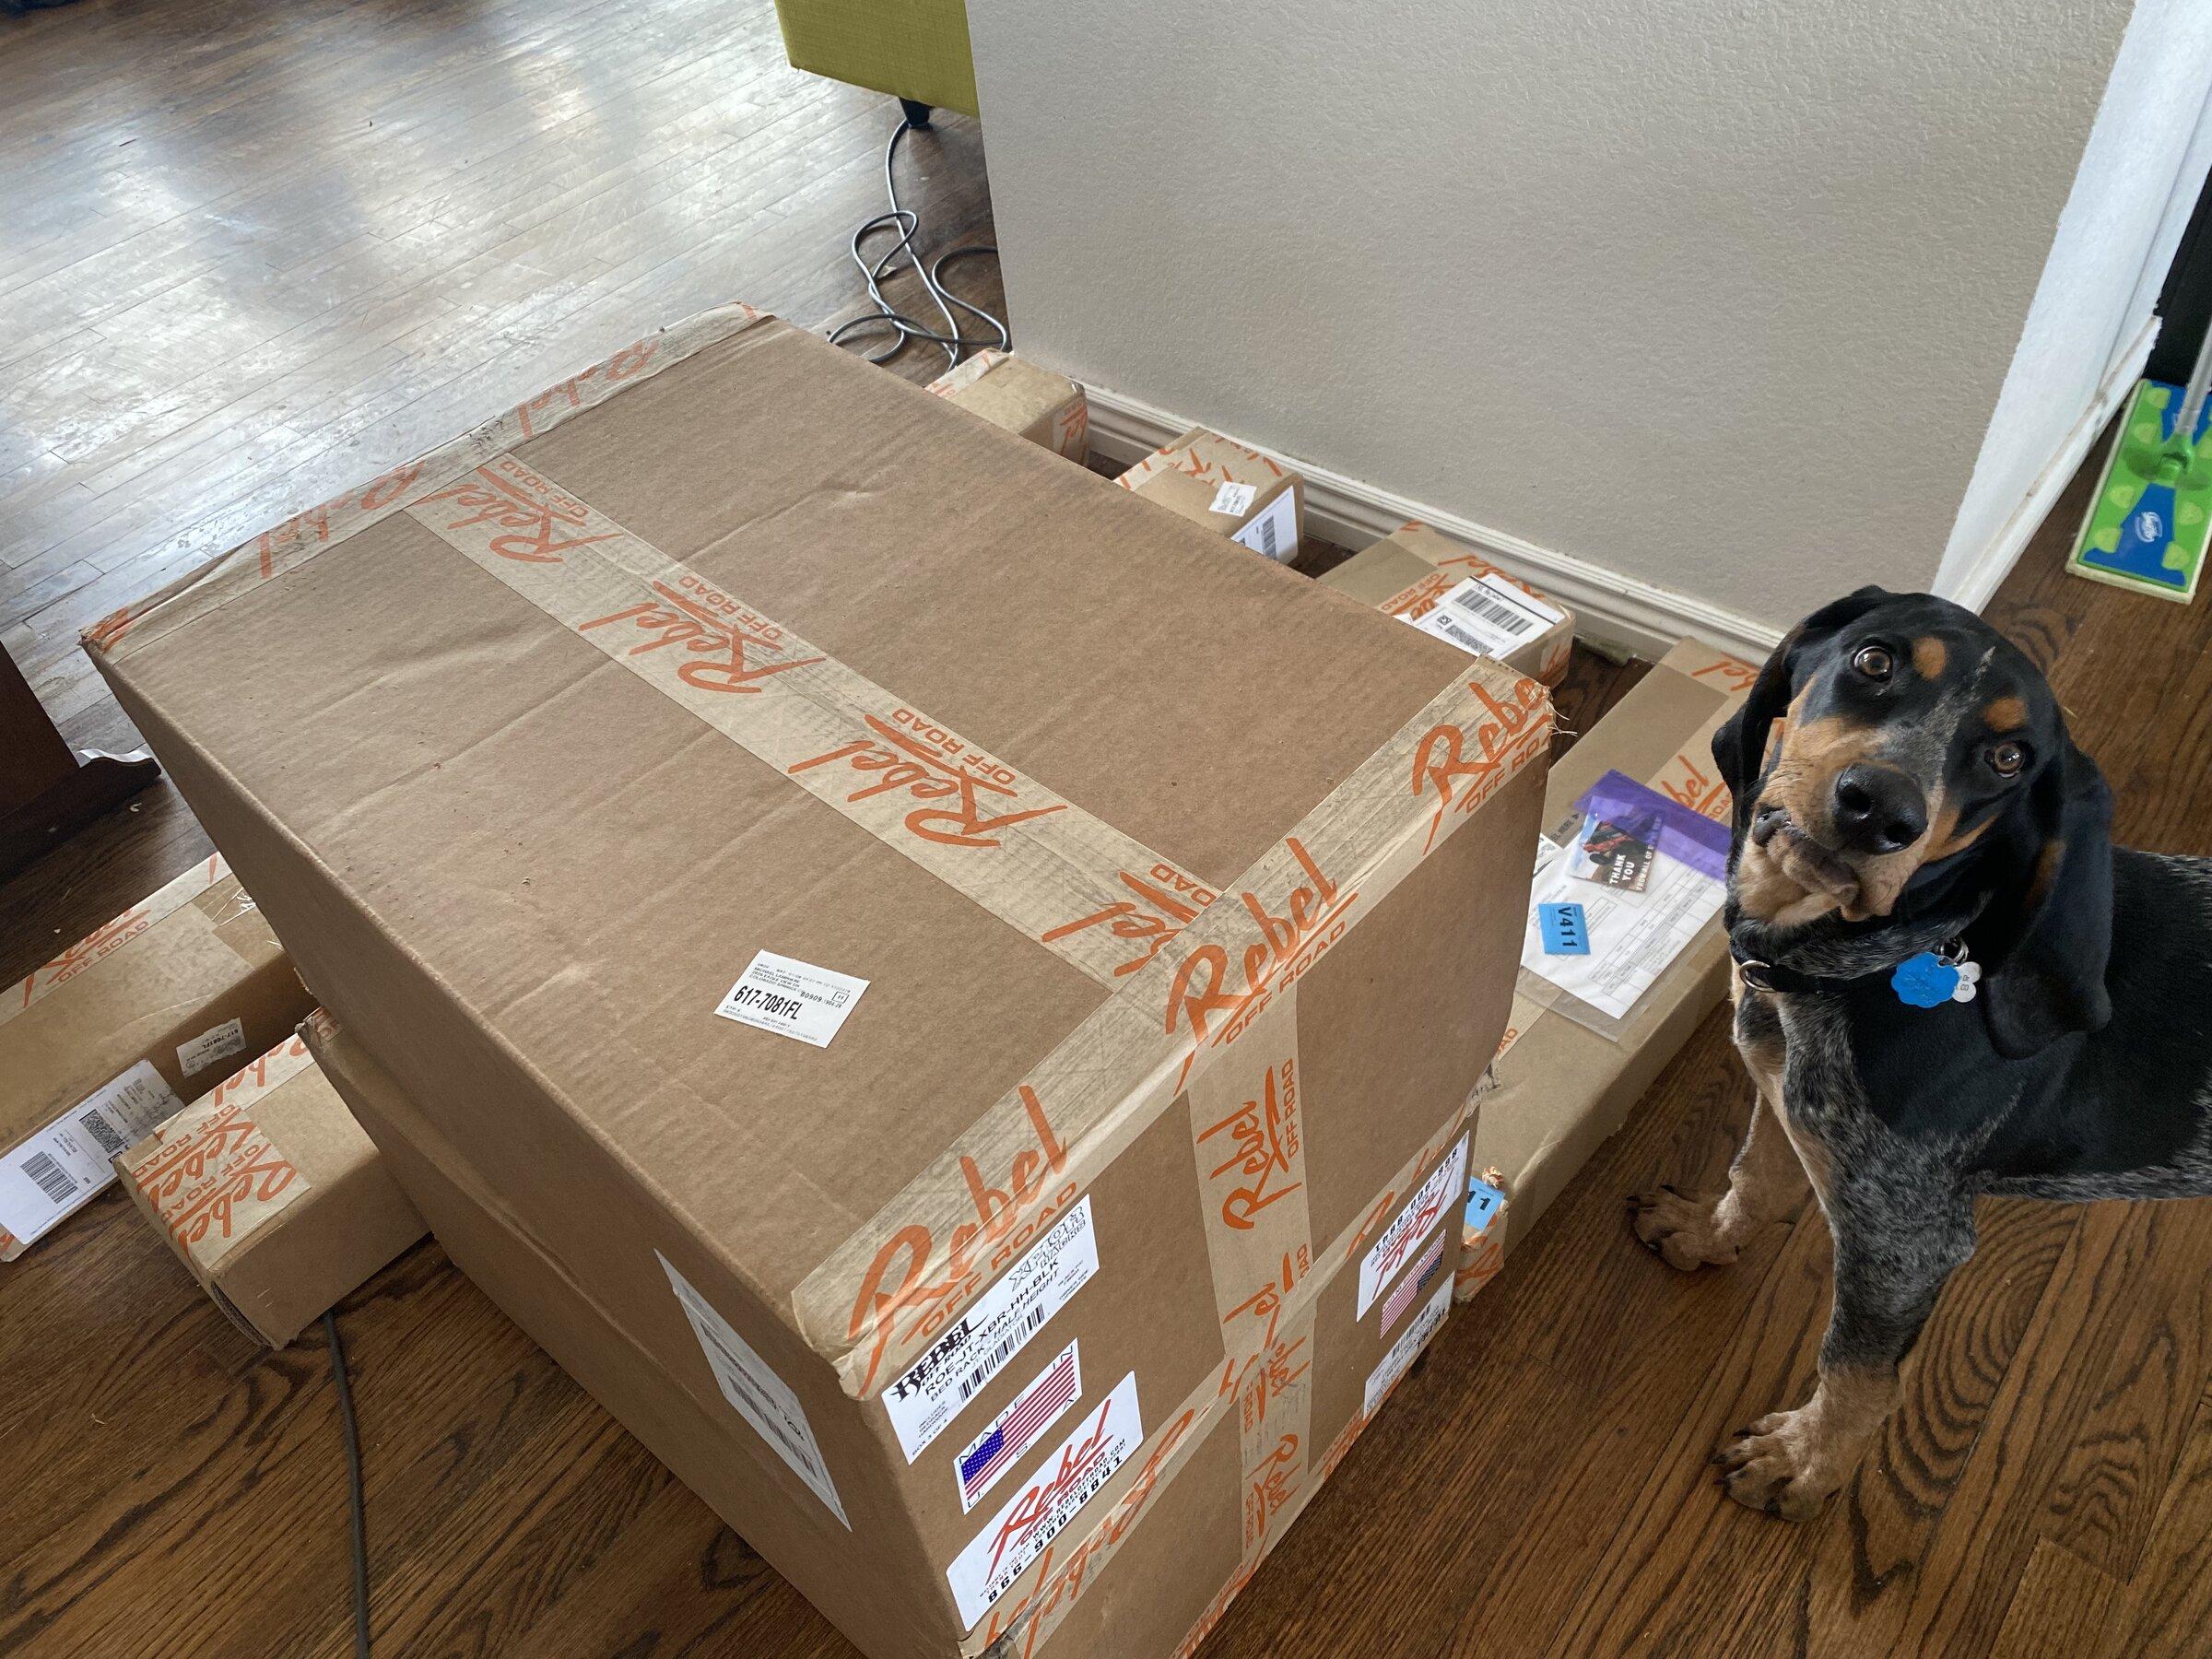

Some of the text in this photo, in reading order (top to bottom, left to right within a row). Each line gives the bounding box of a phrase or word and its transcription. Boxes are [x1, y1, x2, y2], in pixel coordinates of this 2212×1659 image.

[414, 484, 624, 563] Rebel
[499, 461, 590, 519] OFF ROAD
[678, 574, 783, 641] OFF ROAD
[1381, 587, 1418, 611] ROAD
[579, 602, 811, 693] Rebel
[890, 707, 1017, 785] OFF ROAD
[1412, 677, 1547, 857] Rebe
[788, 739, 1068, 848] Rebel
[1465, 769, 1506, 814] OFF
[1149, 863, 1217, 908] OAD
[1609, 853, 1627, 885] THANK
[1621, 862, 1636, 882] YOU
[56, 920, 150, 983] OFF ROAD
[1165, 837, 1337, 1097] Rebel
[1558, 906, 1578, 947] V411
[734, 985, 804, 1020] 617-7081FL
[800, 991, 823, 1003] 80909
[1227, 922, 1346, 1045] OFF ROAD
[197, 1104, 237, 1135] OFF
[1281, 1058, 1300, 1159] OFF ROAD
[132, 1133, 193, 1179] ROAD
[161, 1143, 262, 1225] OFF ROAD
[1196, 1100, 1302, 1230] Rebel
[847, 1085, 1067, 1399] Rebel
[921, 1182, 1077, 1337] OFF ROAD
[889, 1313, 989, 1403] REBEL
[924, 1256, 1059, 1396] ROE-JT-XBR-HH-BLK
[930, 1374, 953, 1403] BED
[955, 1343, 984, 1377] RACK
[992, 1305, 1022, 1339] HALF
[1022, 1266, 1060, 1310] HEIGHT
[959, 1345, 1074, 1465] MADE IN
[985, 1398, 1112, 1586] Rebel
[1018, 1449, 1105, 1547] OFF ROAD
[1245, 1433, 1302, 1516] Rebel
[987, 1456, 1124, 1604] 866-900-8841
